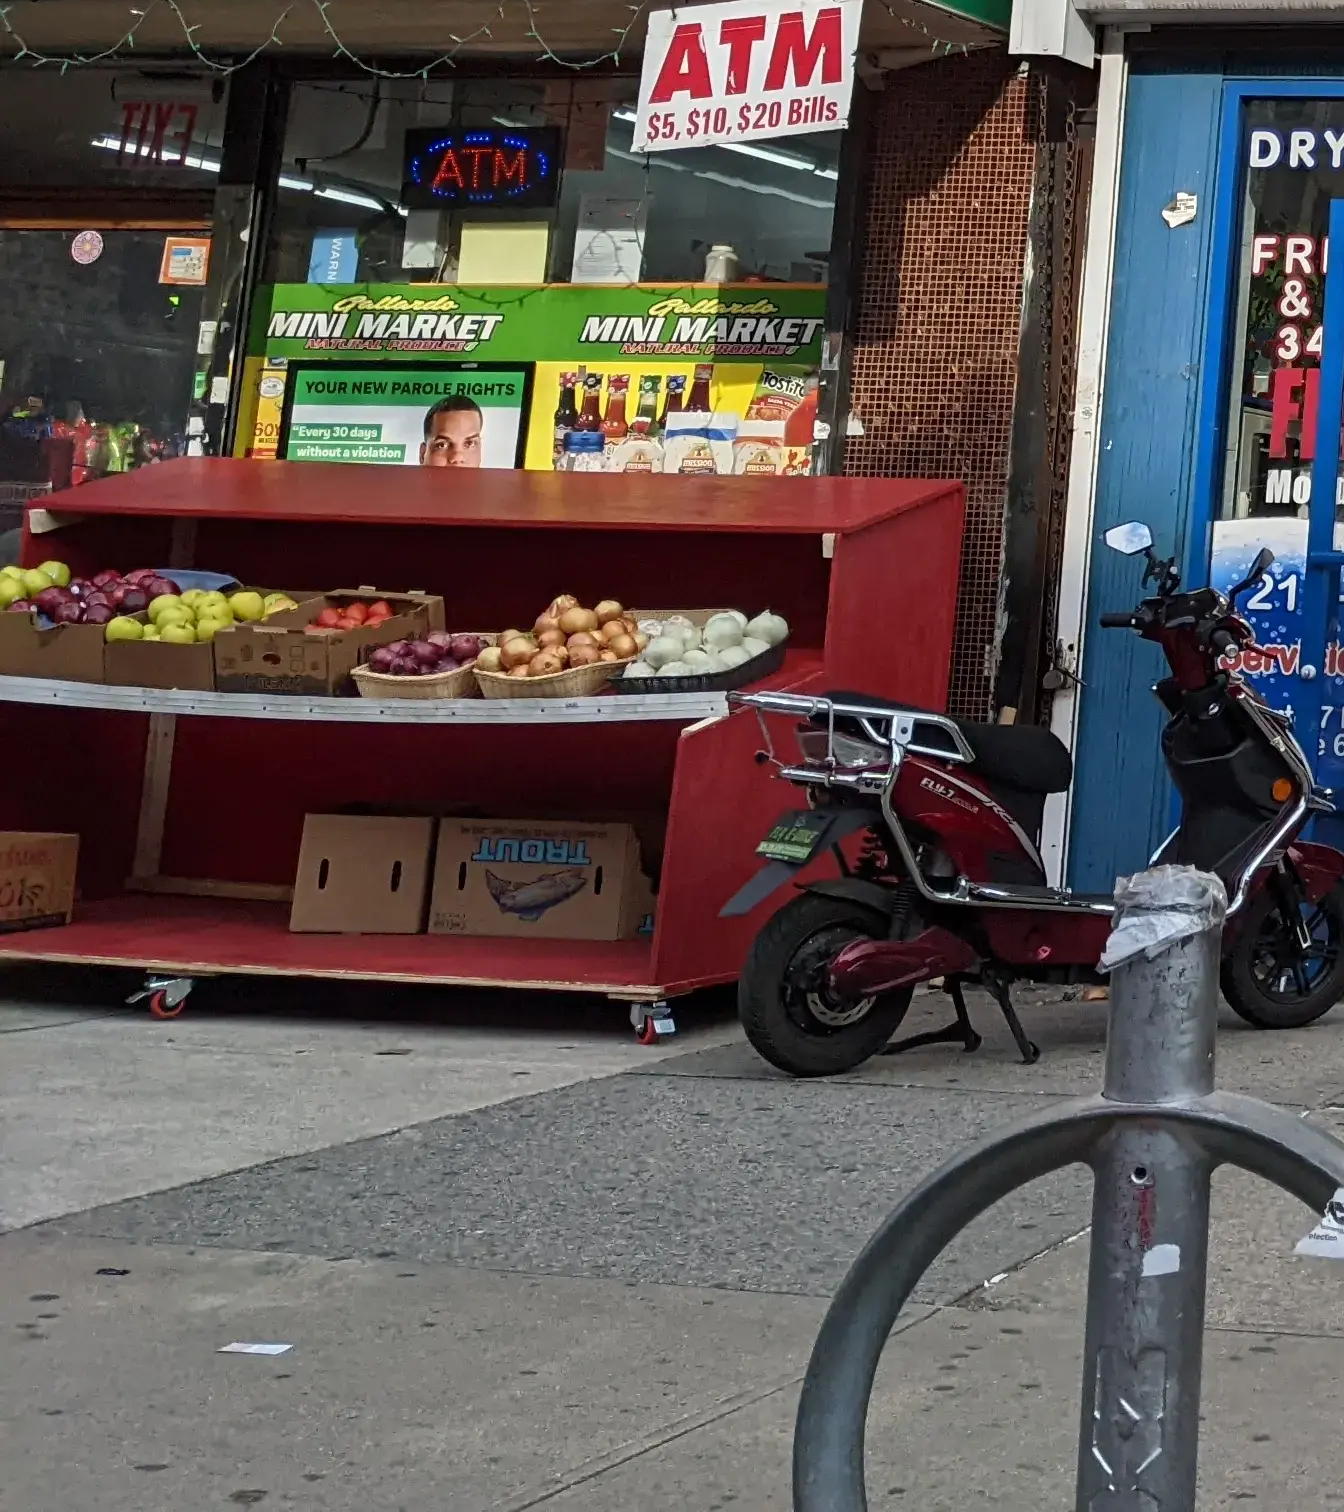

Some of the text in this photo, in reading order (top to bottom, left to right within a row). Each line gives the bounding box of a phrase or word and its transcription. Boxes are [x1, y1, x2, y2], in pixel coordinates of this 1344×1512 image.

[649, 7, 843, 104] ATM
[646, 96, 838, 141] $5, $10, $20 Bills
[431, 148, 527, 190] ATM
[332, 293, 461, 313] Gallardo
[648, 297, 780, 316] Gallardo
[1278, 280, 1312, 318] &
[266, 312, 504, 341] MINI MARKET
[579, 316, 825, 344] MINI MARKET
[304, 338, 383, 351] NATURAL
[619, 342, 702, 355] NATURAL
[305, 381, 516, 397] YOUR NEW PAROLE RIGHTS
[332, 426, 349, 439] 30
[350, 425, 378, 440] days
[297, 446, 402, 460] without a violation
[1321, 704, 1335, 729] 7
[471, 837, 592, 866] TROUT
